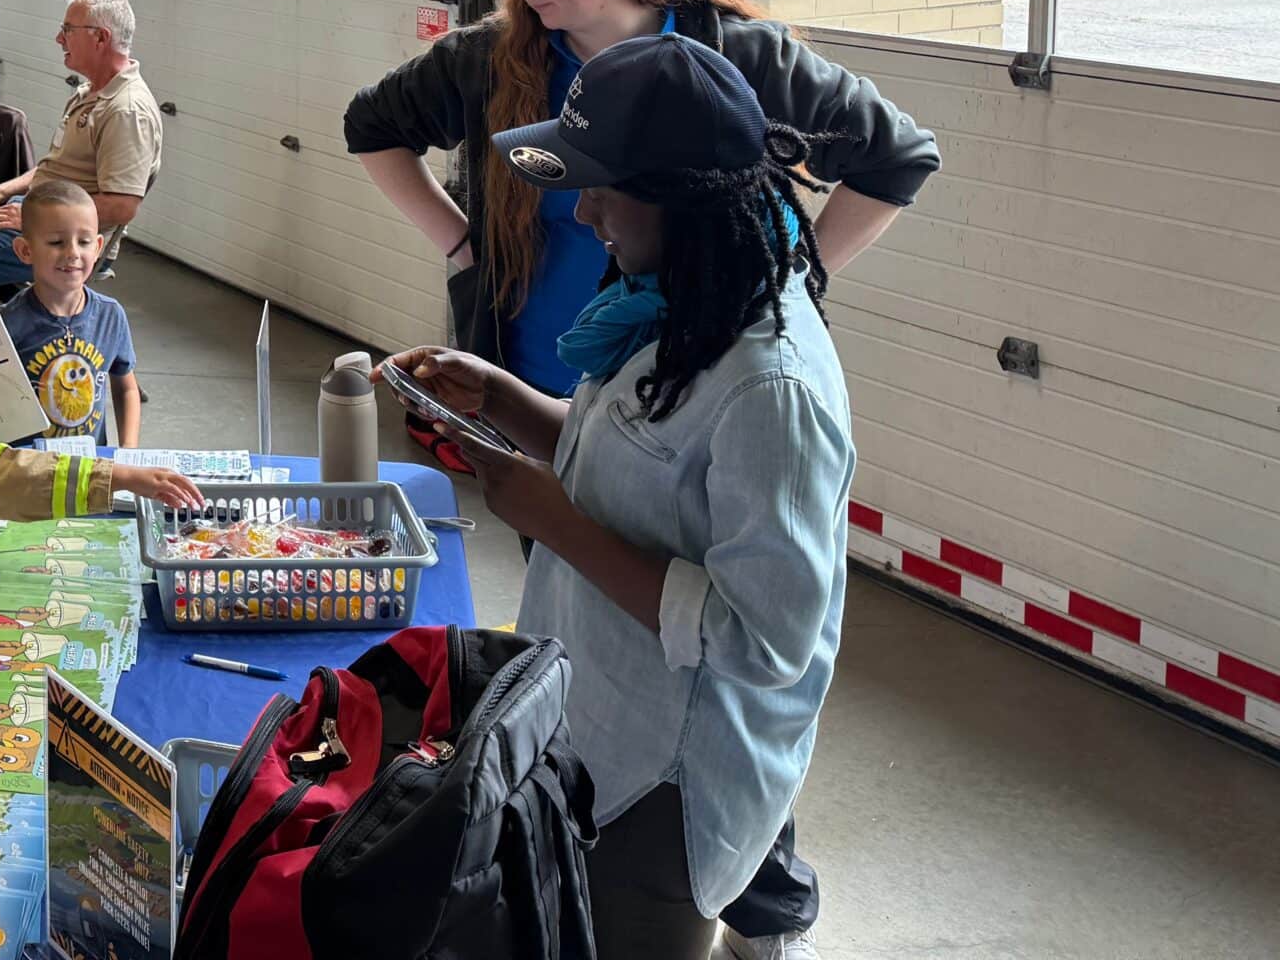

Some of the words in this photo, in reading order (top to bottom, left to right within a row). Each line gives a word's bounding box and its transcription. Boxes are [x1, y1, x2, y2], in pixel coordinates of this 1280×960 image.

[26, 338, 67, 375] MOM'S
[73, 338, 105, 369] MAIN
[90, 757, 121, 795] ATTENTION
[126, 788, 148, 820] NOTICE
